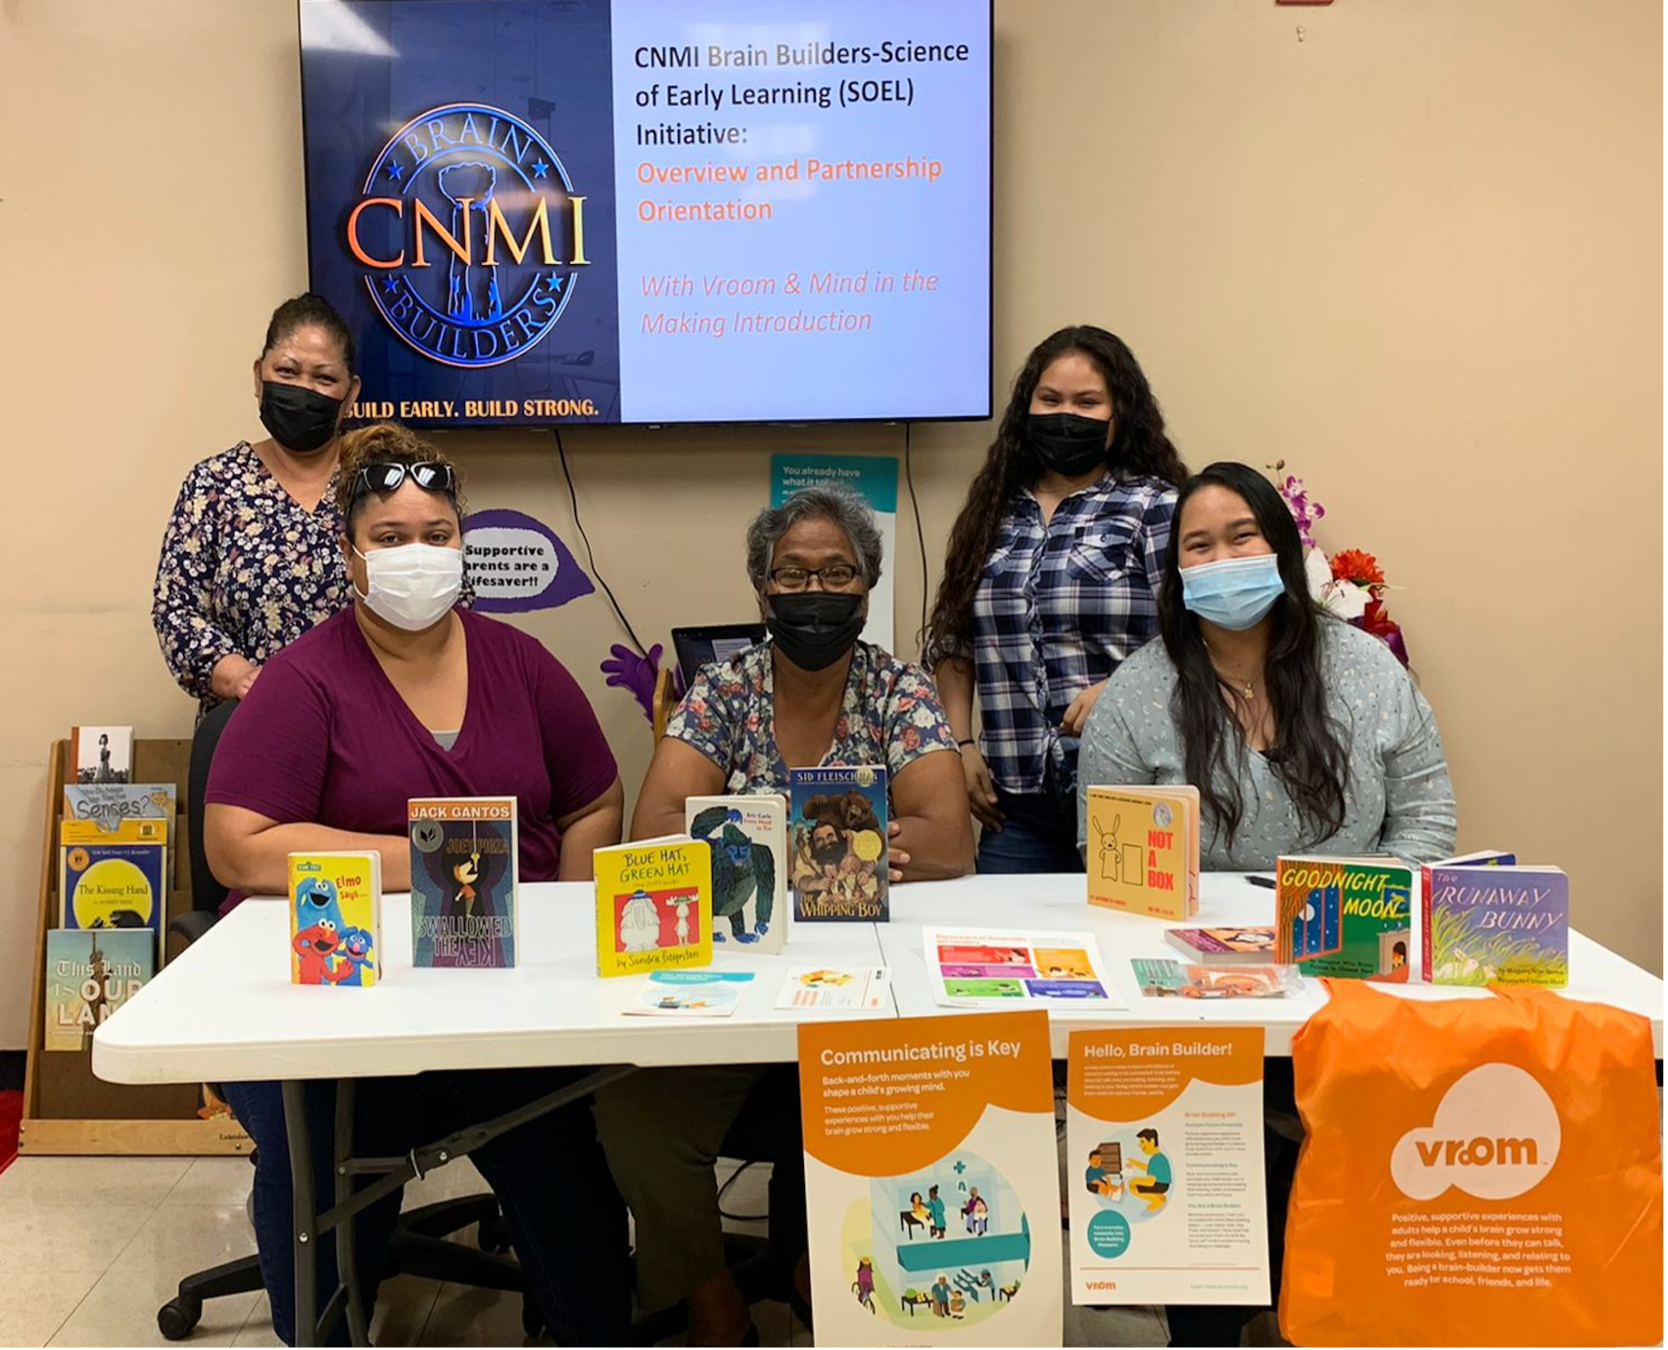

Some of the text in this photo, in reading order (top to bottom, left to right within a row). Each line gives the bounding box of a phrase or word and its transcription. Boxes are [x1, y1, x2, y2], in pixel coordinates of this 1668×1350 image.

[635, 41, 969, 68] CNMI Brain Builders-Science
[635, 79, 915, 110] of Early Learning (SOEL)
[403, 113, 535, 166] BRAIN
[637, 122, 747, 145] Initiative:
[637, 156, 942, 184] Overview and Partnership
[638, 199, 771, 222] Orientation
[348, 196, 591, 268] CNMI
[642, 270, 938, 297] With Vroom & Mind in the
[391, 286, 563, 361] BUILDERS
[642, 310, 871, 337] Making Introduction
[400, 400, 458, 419] EARLY.
[465, 400, 518, 419] BUILD
[523, 399, 598, 418] STRONG.
[783, 466, 860, 477] You already have
[783, 478, 805, 486] what
[465, 545, 544, 557] Supportive
[466, 561, 509, 571] arents
[797, 772, 878, 782] SID FLEISCHMAN
[77, 796, 150, 818] Senses?
[411, 806, 510, 818] JACK GANTOS
[1148, 830, 1174, 849] NOT
[623, 848, 686, 867] BLUE HAT,
[1148, 850, 1156, 868] A
[336, 876, 361, 888] Elmo
[620, 863, 691, 883] GREEN HAT
[1148, 870, 1174, 891] BOX
[1282, 869, 1390, 892] GOODNIGHT
[1436, 873, 1458, 882] The
[79, 885, 148, 895] The Kissing Hand
[1438, 886, 1551, 910] RUNAWAY
[799, 902, 882, 918] WHIPPING BOY
[1343, 898, 1400, 919] MOON
[416, 916, 512, 938] SWALLOWED
[1478, 911, 1563, 934] BUNNY
[433, 936, 458, 957] THE
[57, 960, 141, 977] This Land
[617, 949, 699, 969] by Sandra Boynton
[58, 1003, 118, 1025] LAN
[821, 1039, 1020, 1065] Communicating is Key
[1084, 1043, 1232, 1058] Hello, Brain Builder!
[823, 1070, 969, 1085] Back-and-forth moments with you
[823, 1089, 849, 1097] shape
[857, 1086, 885, 1095] child's
[886, 1084, 920, 1096] growing
[921, 1082, 945, 1091] mind.
[848, 1104, 878, 1113] positive,
[879, 1102, 917, 1112] supportive
[1415, 1136, 1537, 1167] vroom
[1392, 1213, 1562, 1222] Positive, supportive experiences with
[1392, 1227, 1419, 1235] adults
[1421, 1226, 1441, 1235] help
[1479, 1225, 1504, 1233] brain
[1506, 1227, 1529, 1235] grow
[1531, 1226, 1562, 1237] strong
[1390, 1239, 1407, 1247] and
[1409, 1239, 1443, 1247] flexible.
[1468, 1237, 1500, 1246] before
[1502, 1239, 1523, 1248] they
[1543, 1240, 1563, 1248] talk,
[1386, 1252, 1405, 1261] they
[1422, 1251, 1456, 1261] looking,
[1459, 1251, 1500, 1261] listening,
[1522, 1252, 1558, 1261] relating
[1386, 1267, 1404, 1276] you.
[1407, 1264, 1431, 1273] Being
[1439, 1263, 1501, 1273] brain-builder
[1524, 1266, 1544, 1275] gets
[1545, 1265, 1571, 1273] them
[1086, 1280, 1116, 1291] vroom
[1404, 1277, 1428, 1286] ready
[1442, 1276, 1475, 1285] school,
[1478, 1277, 1514, 1287] friends,
[1516, 1278, 1533, 1286] and
[1535, 1278, 1552, 1286] life.
